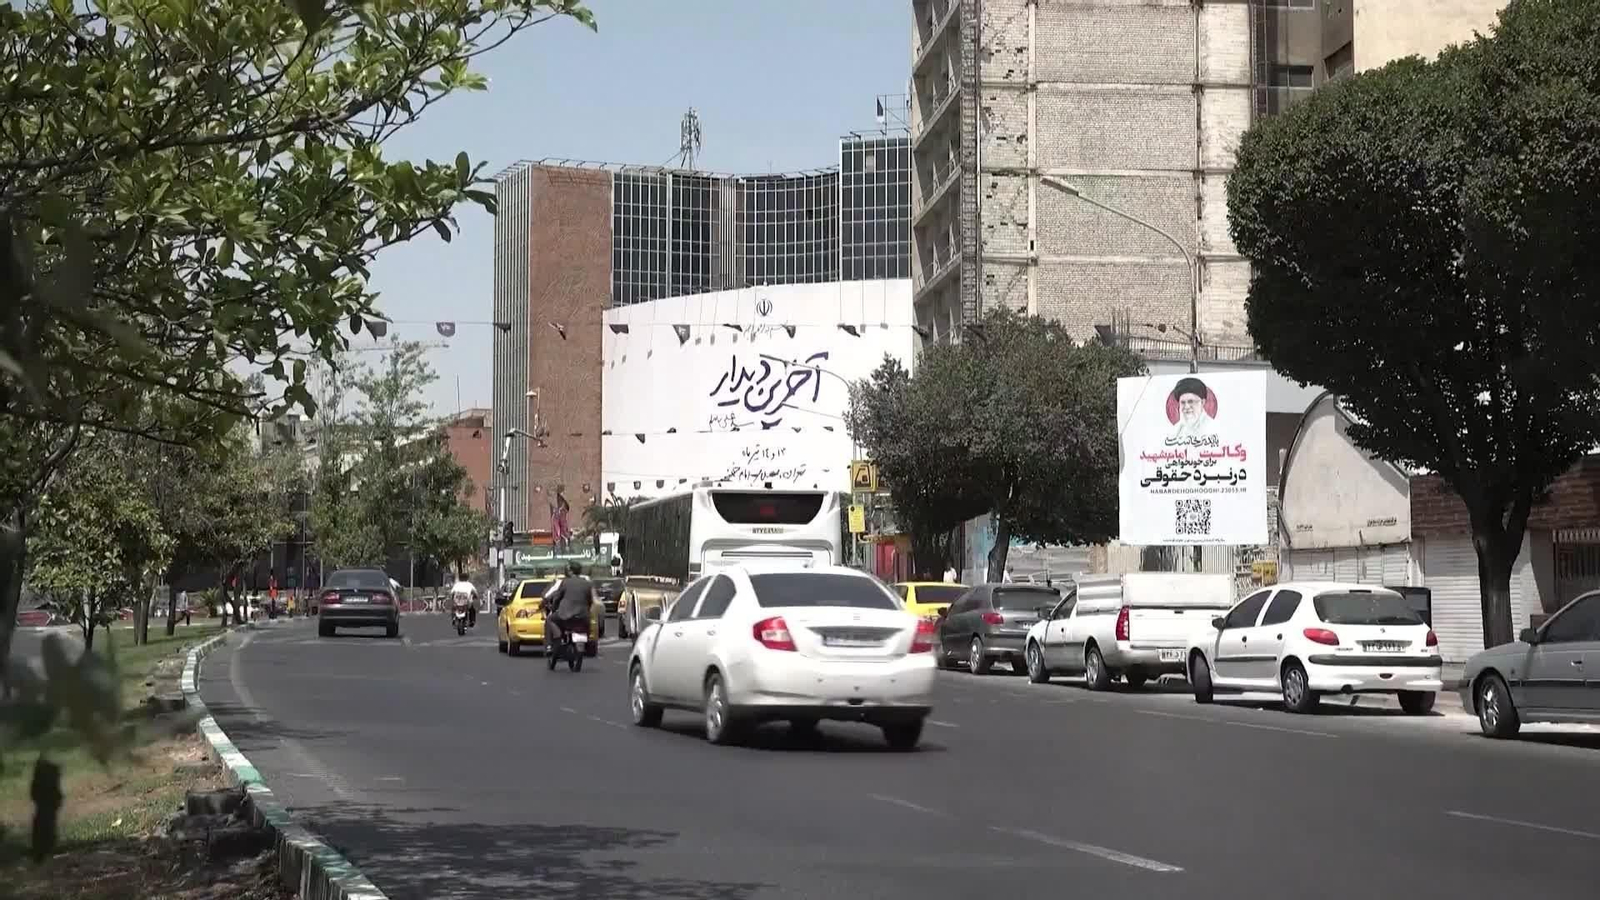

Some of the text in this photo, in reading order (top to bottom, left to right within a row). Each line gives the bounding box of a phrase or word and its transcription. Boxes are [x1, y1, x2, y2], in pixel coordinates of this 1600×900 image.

[709, 351, 829, 430] آخرین دیدار
[1139, 443, 1247, 463] وکالت امام شهید
[1165, 456, 1218, 469] برای خونخواهی
[1140, 467, 1247, 487] در نبرد حقوقی
